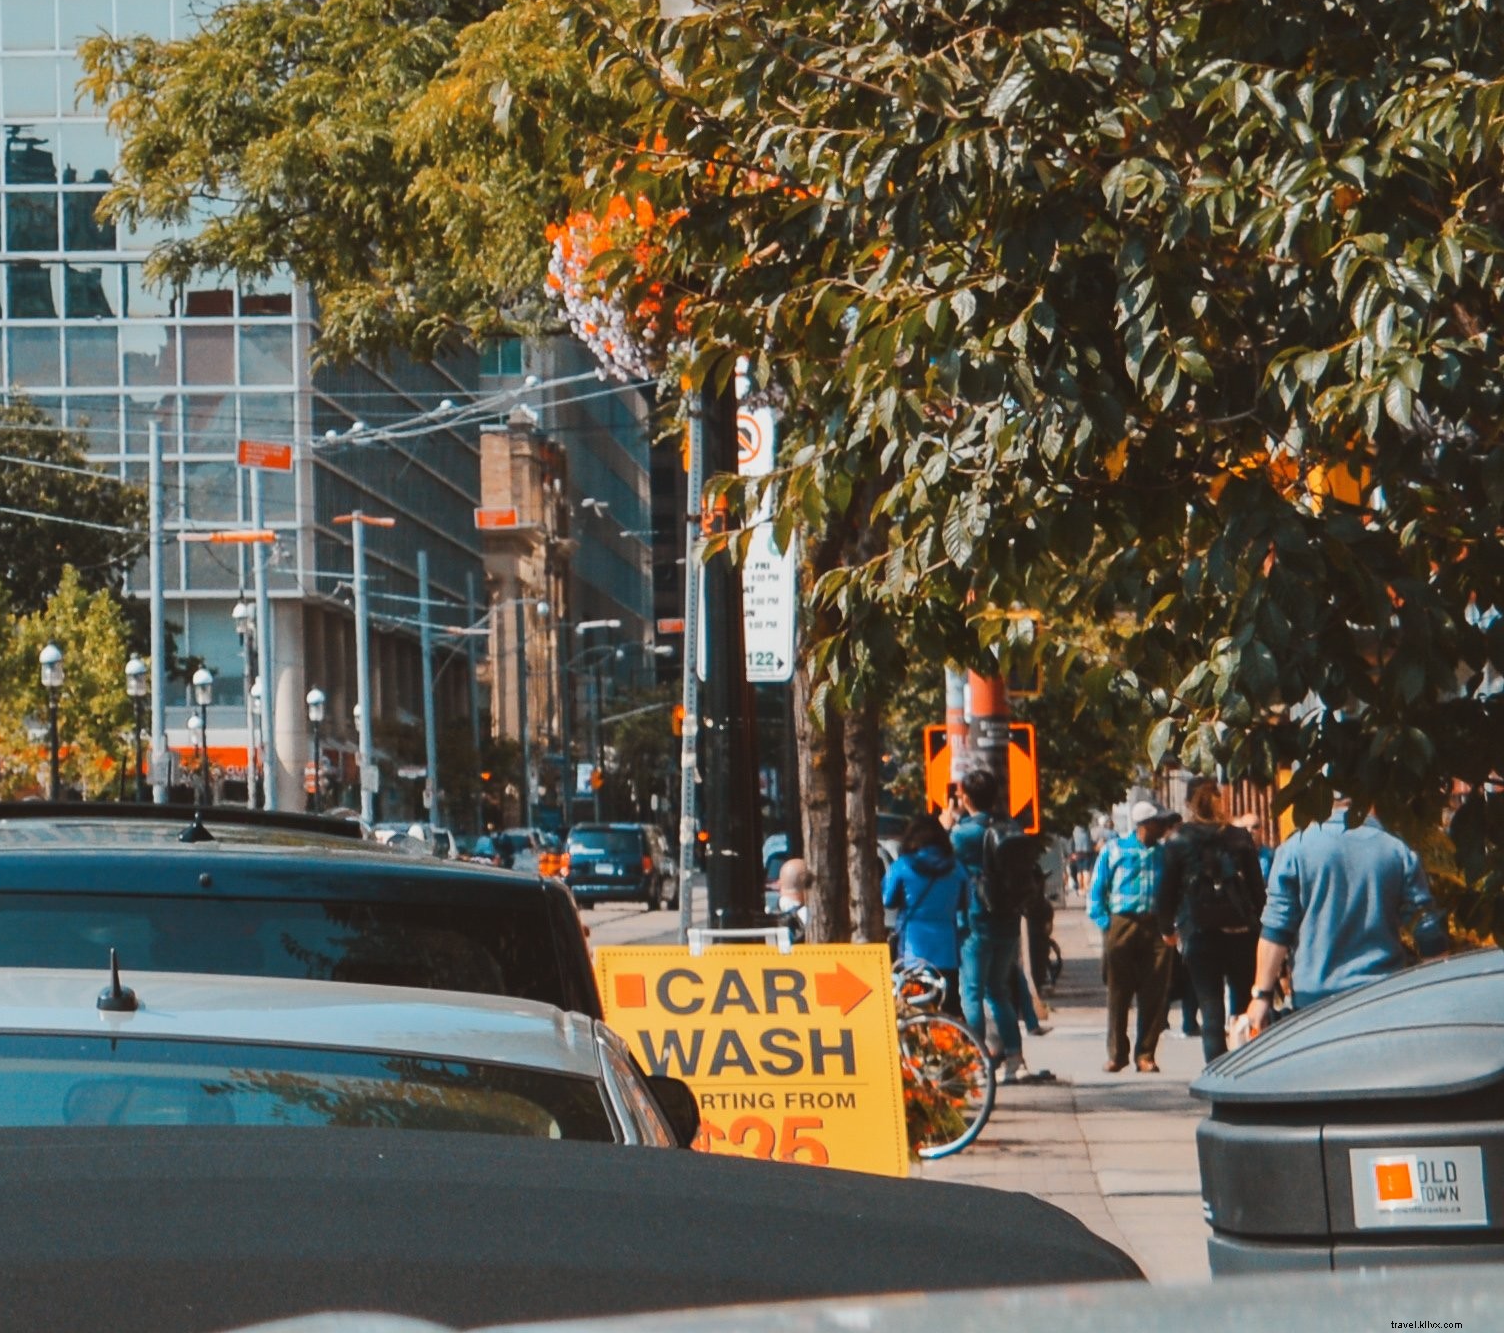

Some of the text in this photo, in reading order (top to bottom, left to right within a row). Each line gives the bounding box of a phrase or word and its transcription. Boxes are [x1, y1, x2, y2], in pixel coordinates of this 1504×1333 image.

[656, 968, 810, 1016] CAR
[637, 1028, 856, 1077] WASH
[701, 1093, 856, 1110] RTING FROM
[1417, 1160, 1457, 1184] OLD
